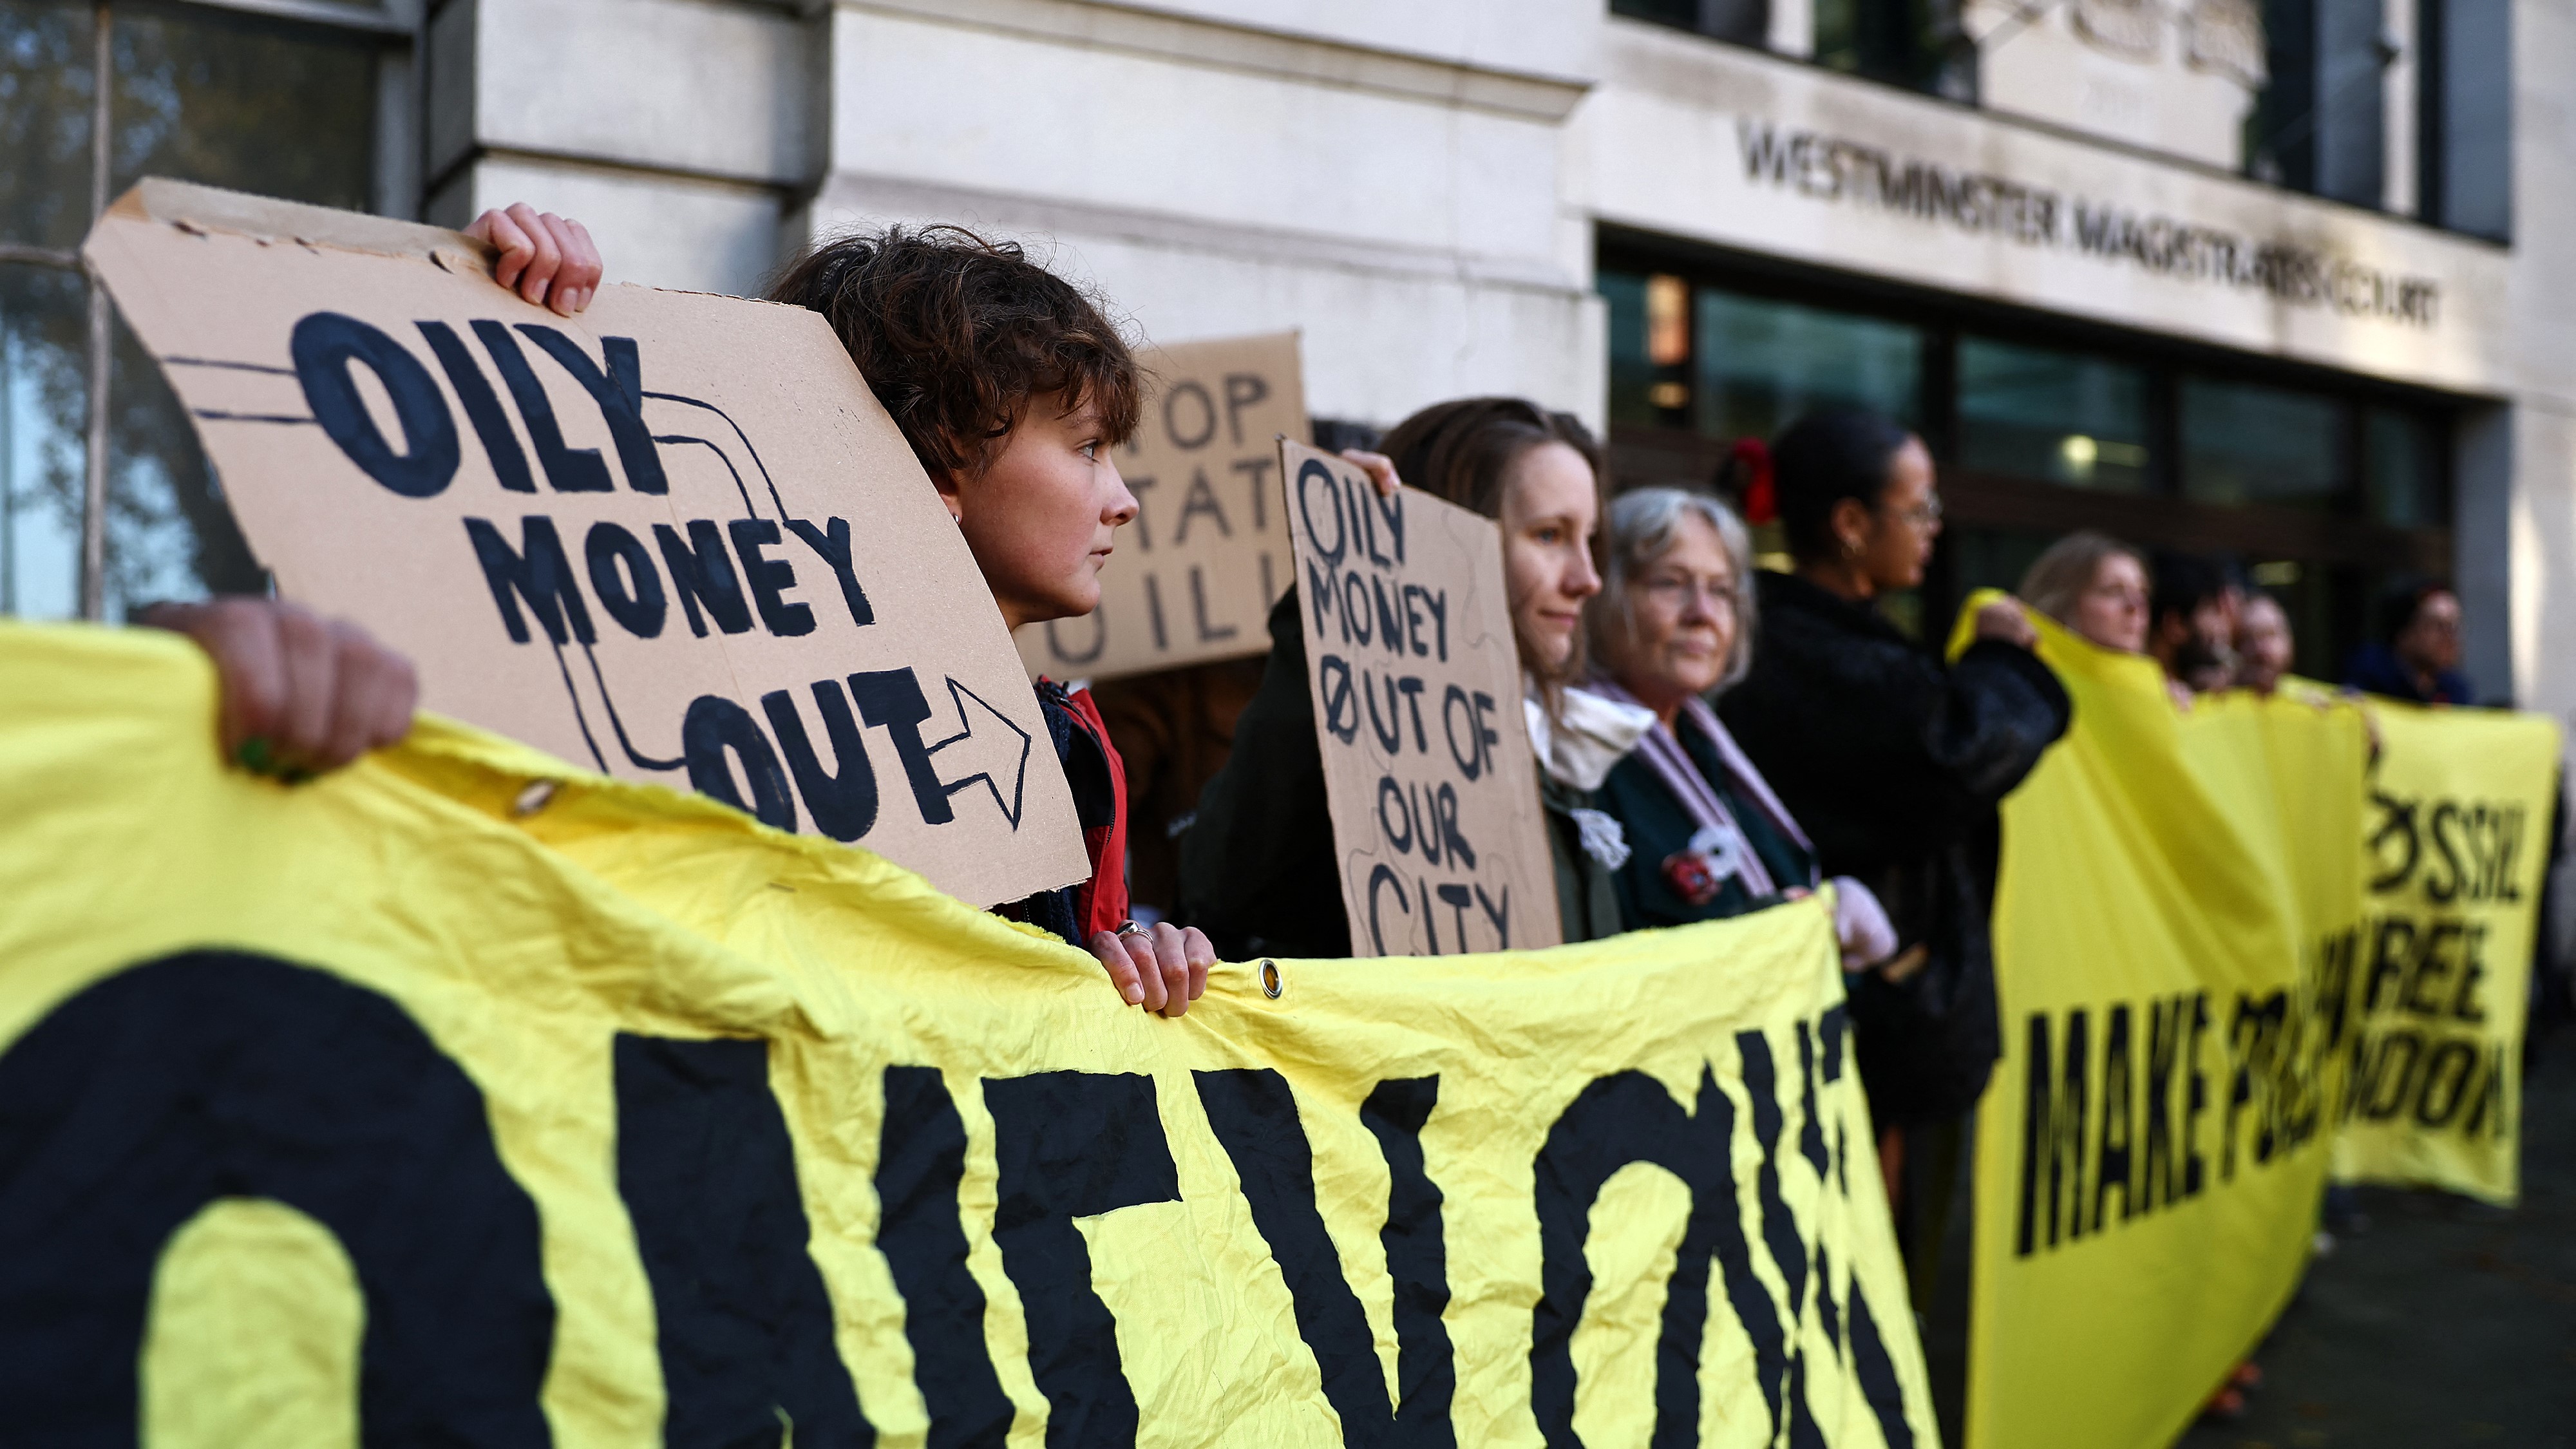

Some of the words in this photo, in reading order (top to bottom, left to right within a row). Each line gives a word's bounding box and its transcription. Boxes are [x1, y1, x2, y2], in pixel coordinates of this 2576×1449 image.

[291, 310, 668, 498] OILY
[1297, 458, 1405, 569] OILY
[463, 515, 875, 645] MONEY
[1306, 556, 1447, 663] MONEY
[683, 665, 956, 843] OUT
[1443, 683, 1499, 783] OF
[1378, 775, 1476, 872] OUR
[1368, 862, 1510, 957] CITY
[2013, 989, 2211, 1262] MAKE
